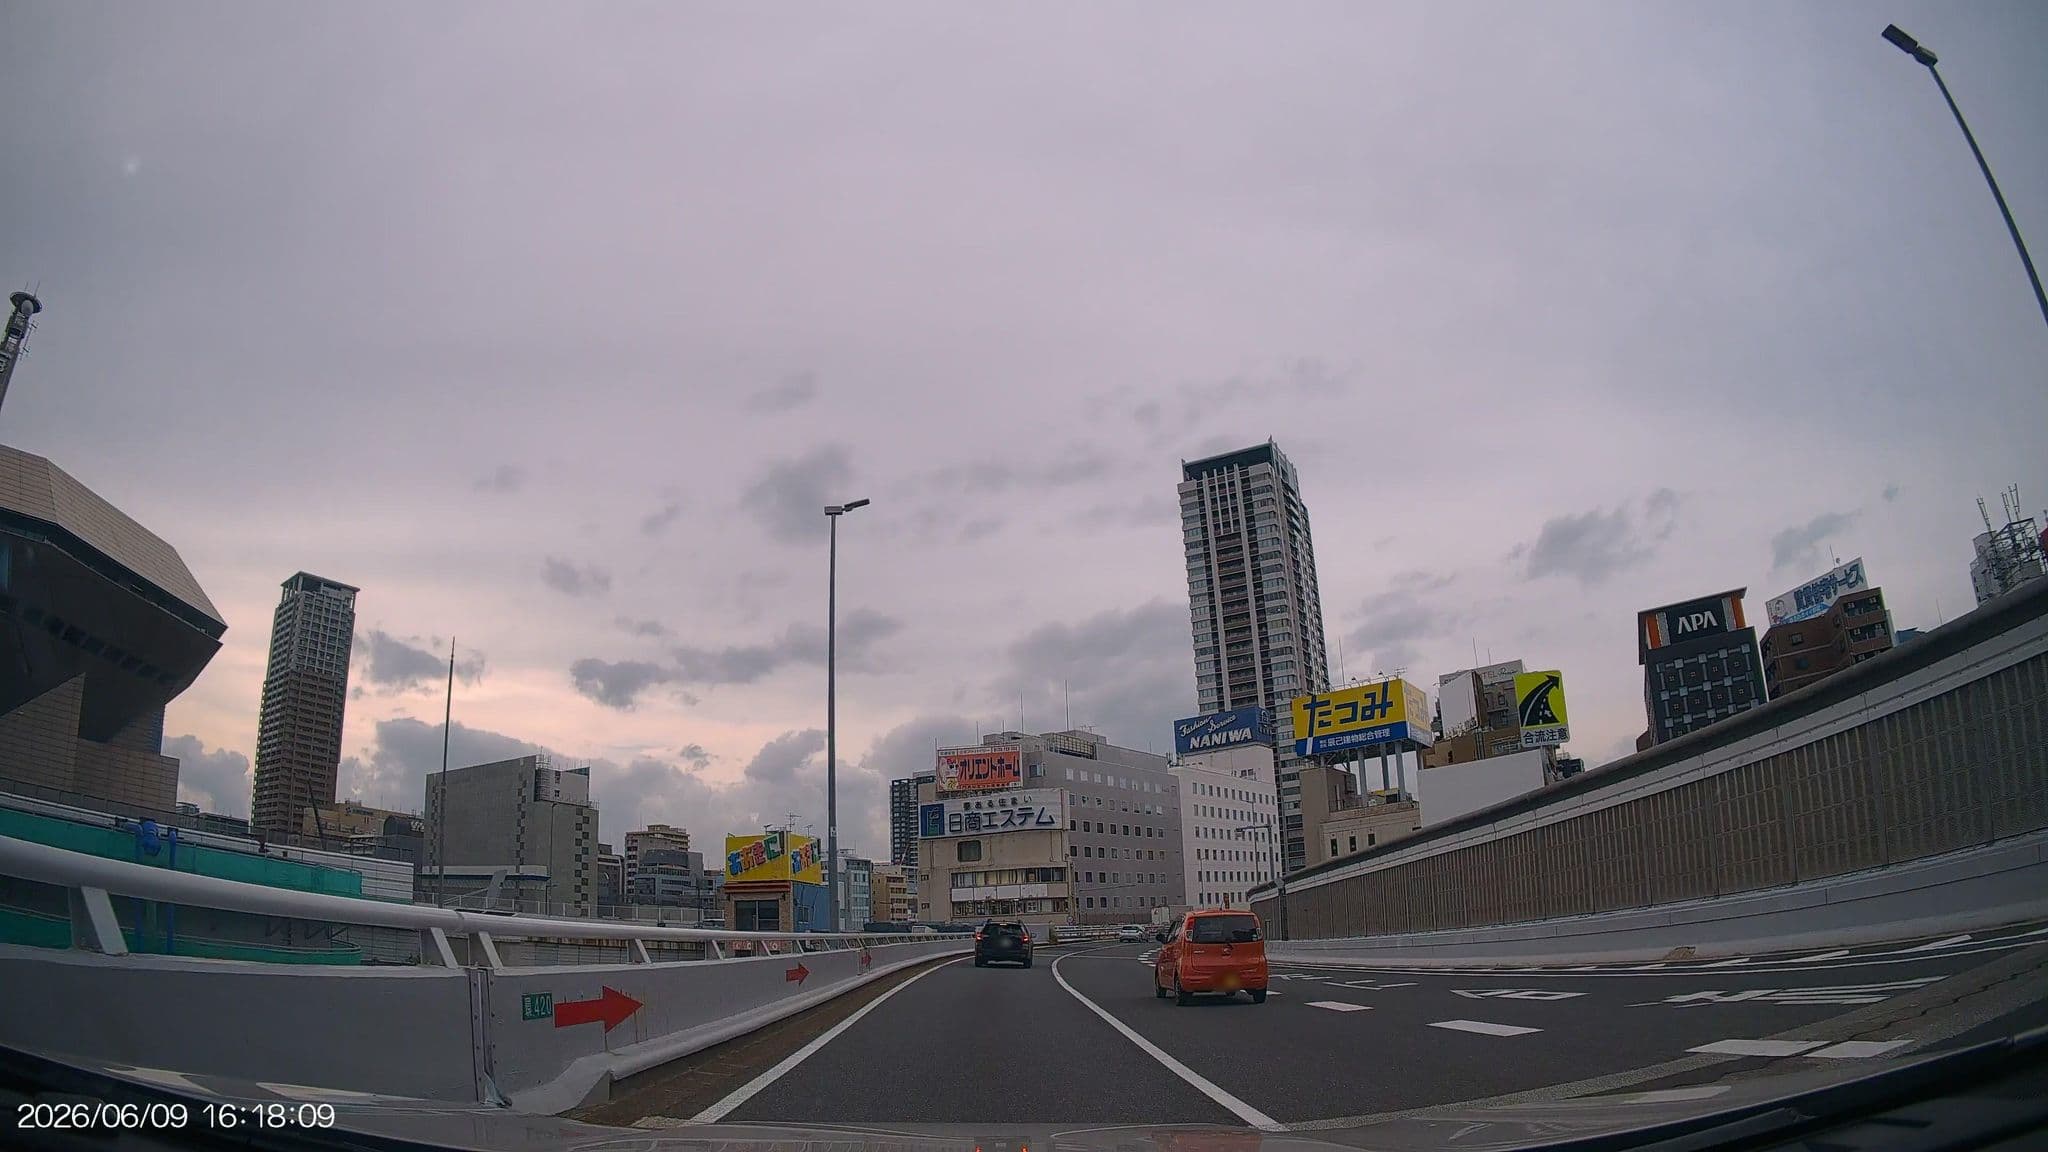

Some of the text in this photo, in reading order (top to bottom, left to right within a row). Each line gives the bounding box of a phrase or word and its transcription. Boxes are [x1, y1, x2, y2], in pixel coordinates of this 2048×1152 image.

[1677, 610, 1718, 634] APA
[1179, 715, 1213, 737] Fashion
[1207, 714, 1237, 733] Service
[1303, 681, 1394, 746] たつみ
[1189, 727, 1253, 749] NANIWA
[1523, 728, 1569, 744] 合流注意
[959, 756, 1021, 780] オリエントホーム
[948, 806, 1056, 834] 日商エステム
